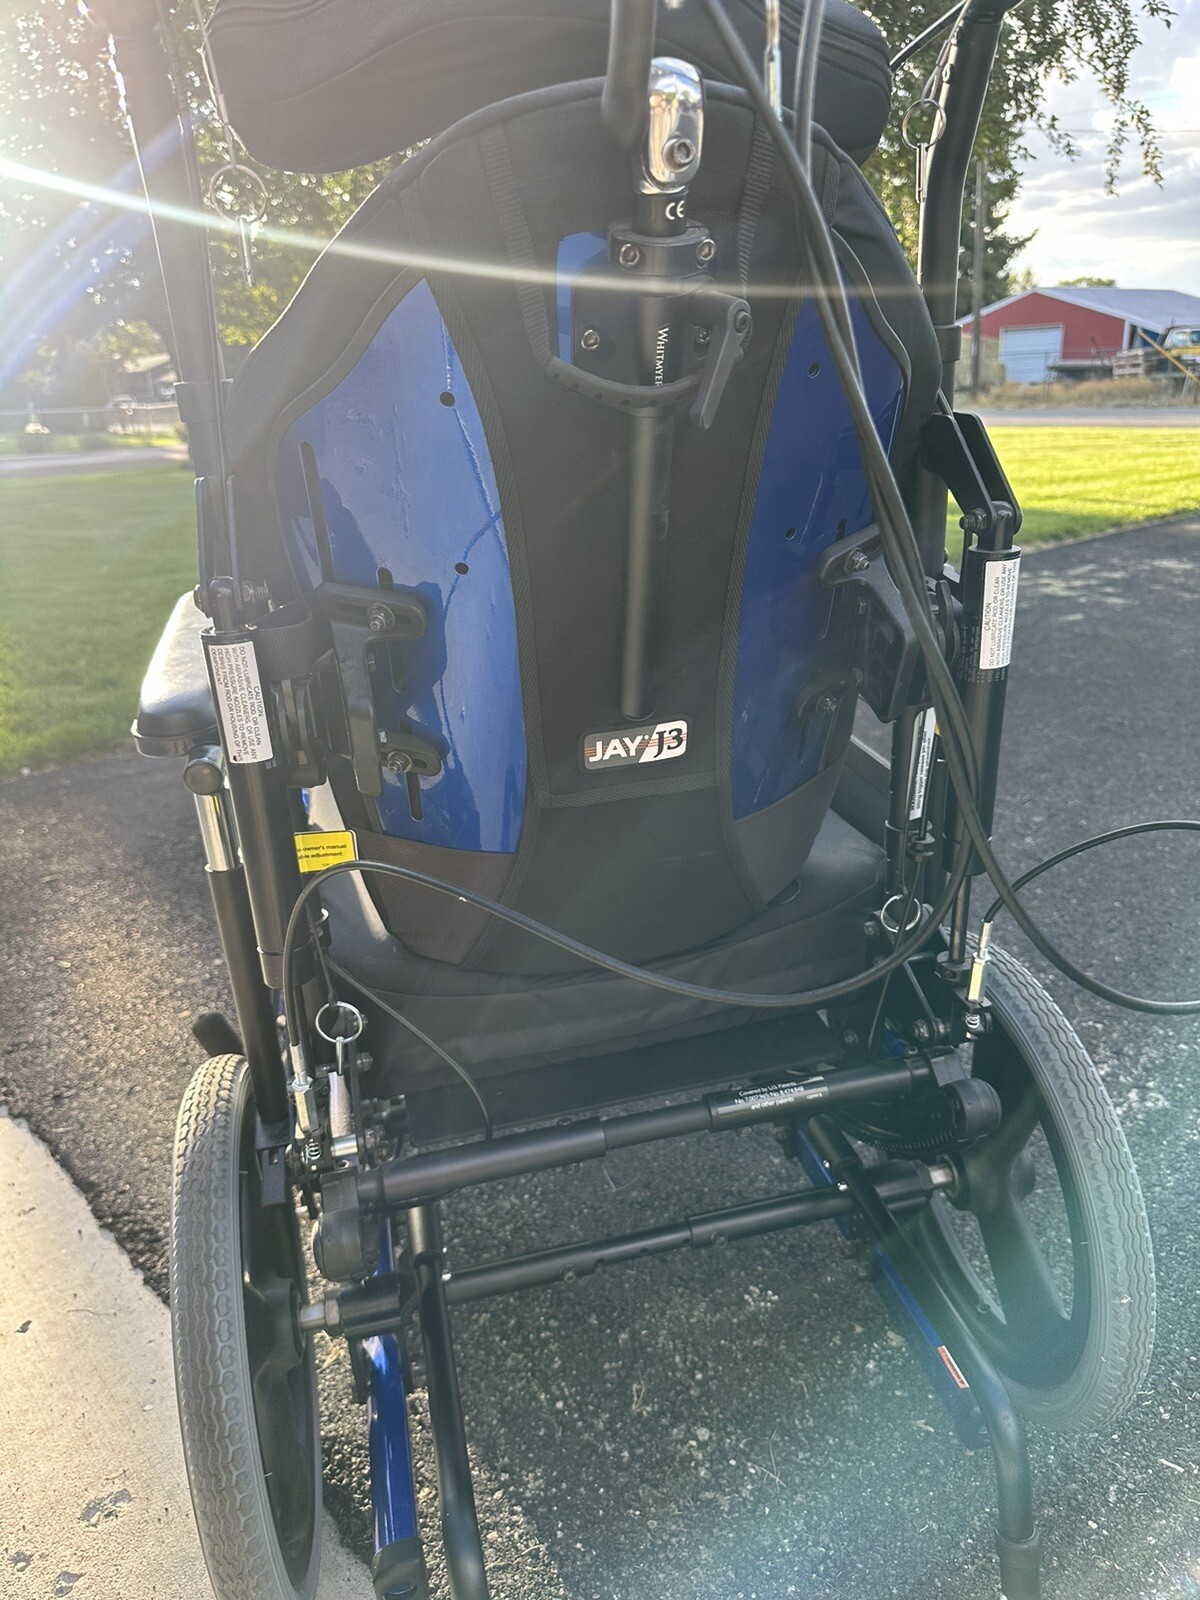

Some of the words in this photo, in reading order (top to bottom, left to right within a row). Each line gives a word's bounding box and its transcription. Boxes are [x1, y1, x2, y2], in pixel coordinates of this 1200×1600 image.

[665, 200, 684, 220] CE
[655, 327, 669, 386] WHITMYER
[1000, 588, 1005, 596] OR
[239, 647, 245, 655] DO
[243, 669, 253, 701] LUBRICATE
[252, 717, 258, 725] OR
[228, 703, 234, 712] OR
[254, 686, 263, 716] CAUTION
[230, 713, 239, 739] HOUSING
[233, 696, 242, 722] NOZZLES
[240, 732, 249, 755] REMOVE
[246, 726, 252, 734] OR
[589, 735, 644, 762] JAY
[653, 728, 683, 758] J3
